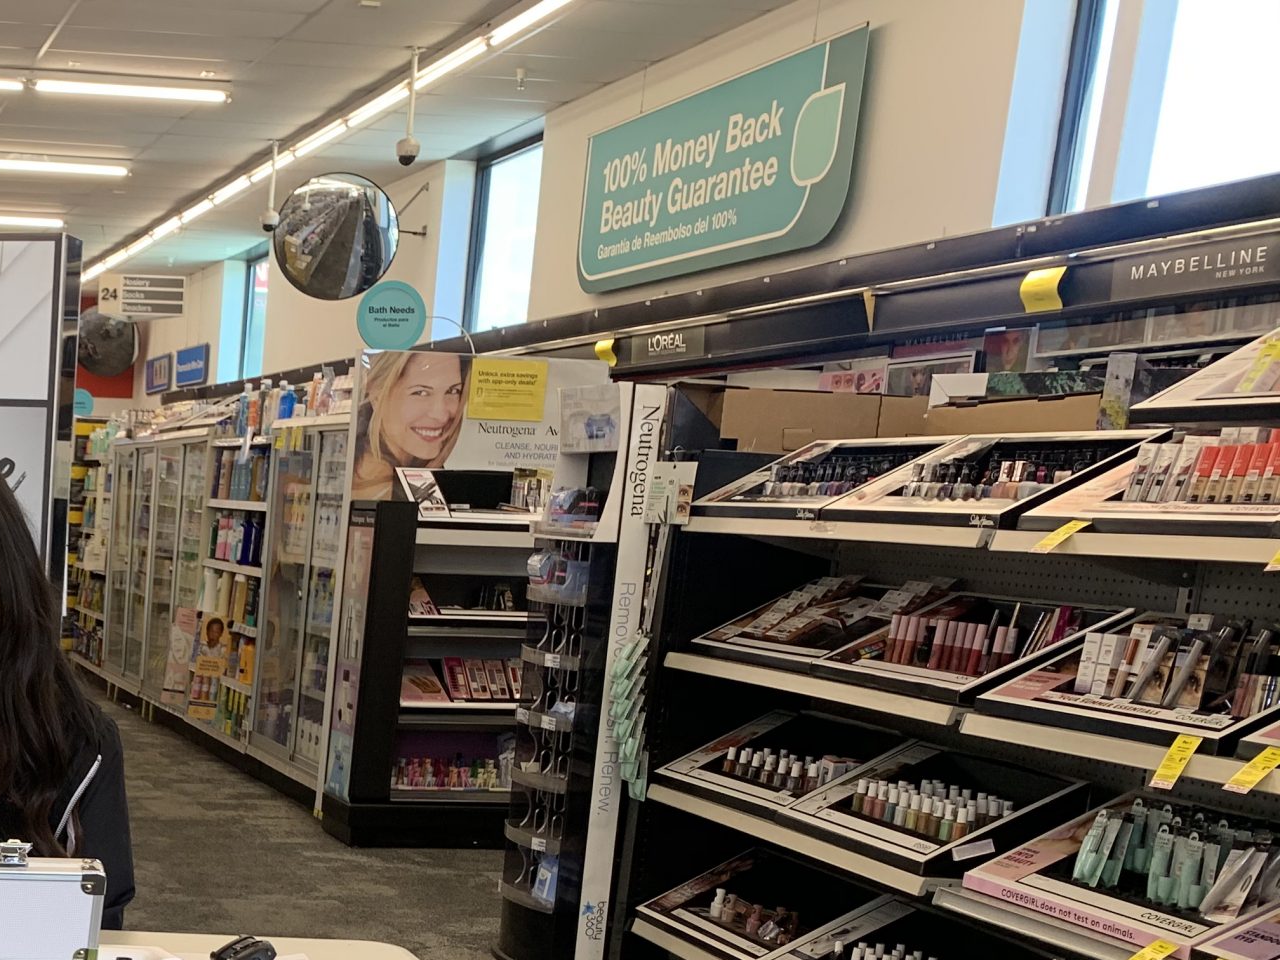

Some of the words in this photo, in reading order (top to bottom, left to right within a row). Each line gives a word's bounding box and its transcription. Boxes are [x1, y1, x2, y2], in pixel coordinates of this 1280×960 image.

[603, 147, 647, 193] 100%
[652, 130, 720, 178] Money
[726, 100, 784, 153] Back
[600, 189, 663, 234] Beauty
[667, 157, 778, 215] Guarantee
[631, 235, 642, 251] de
[644, 222, 692, 249] Reembolso
[694, 216, 709, 234] del
[711, 208, 737, 229] 100%
[1131, 246, 1268, 281] MAYBELLINE
[1215, 269, 1236, 279] NEW
[1238, 265, 1265, 277] YORK
[101, 288, 118, 300] 24
[368, 306, 388, 314] Bath
[389, 306, 415, 314] Needs
[478, 422, 536, 438] Neutrogena
[504, 452, 521, 460] AND
[629, 405, 661, 516] Neutrogena
[1003, 855, 1036, 866] BEAUTY
[592, 901, 607, 940] beauty
[1001, 889, 1039, 908] COVERGIRL
[1040, 901, 1057, 913] does
[1058, 908, 1071, 918] not
[1073, 913, 1088, 924] test
[1091, 920, 1101, 928] on
[1102, 923, 1136, 940] animals.
[1141, 912, 1195, 933] COVERGIRL
[1234, 934, 1257, 944] EYES
